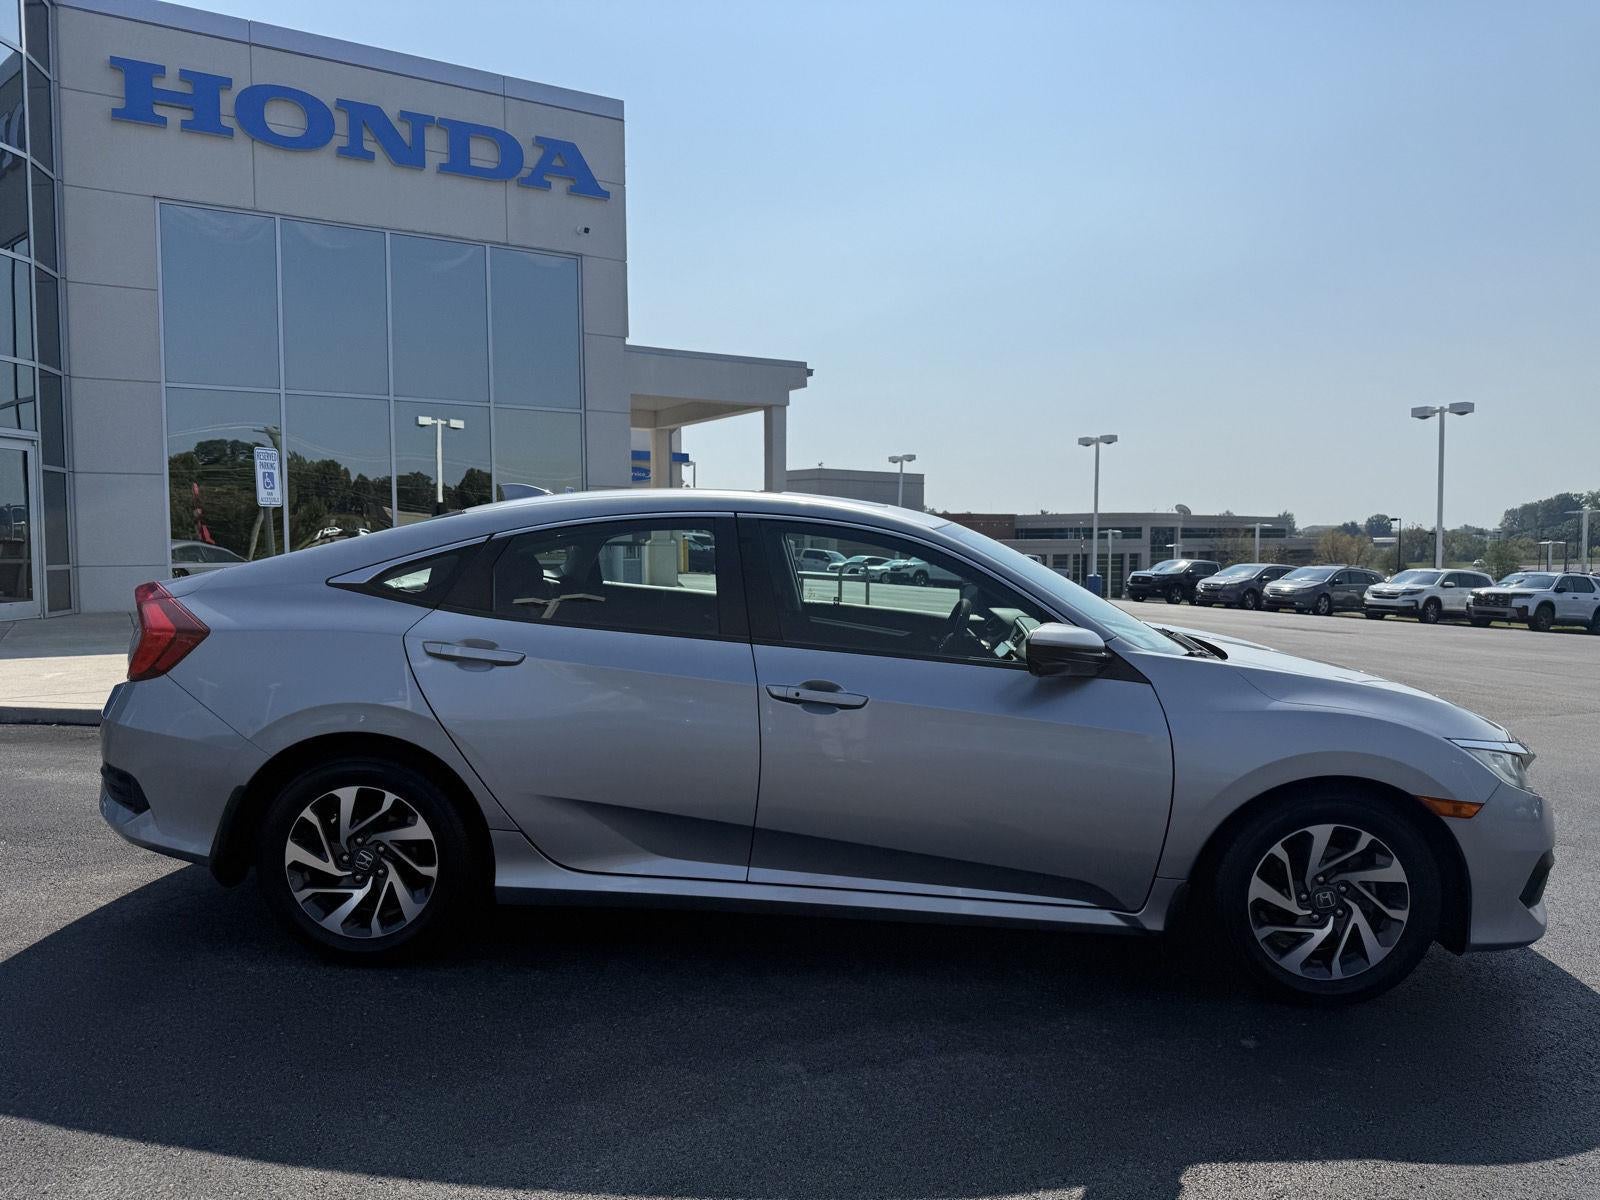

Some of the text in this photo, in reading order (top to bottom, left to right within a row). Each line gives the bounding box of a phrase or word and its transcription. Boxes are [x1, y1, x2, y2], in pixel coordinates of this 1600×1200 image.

[109, 55, 610, 199] HONDA
[256, 451, 277, 461] RESERVED
[259, 462, 276, 470] PARKING
